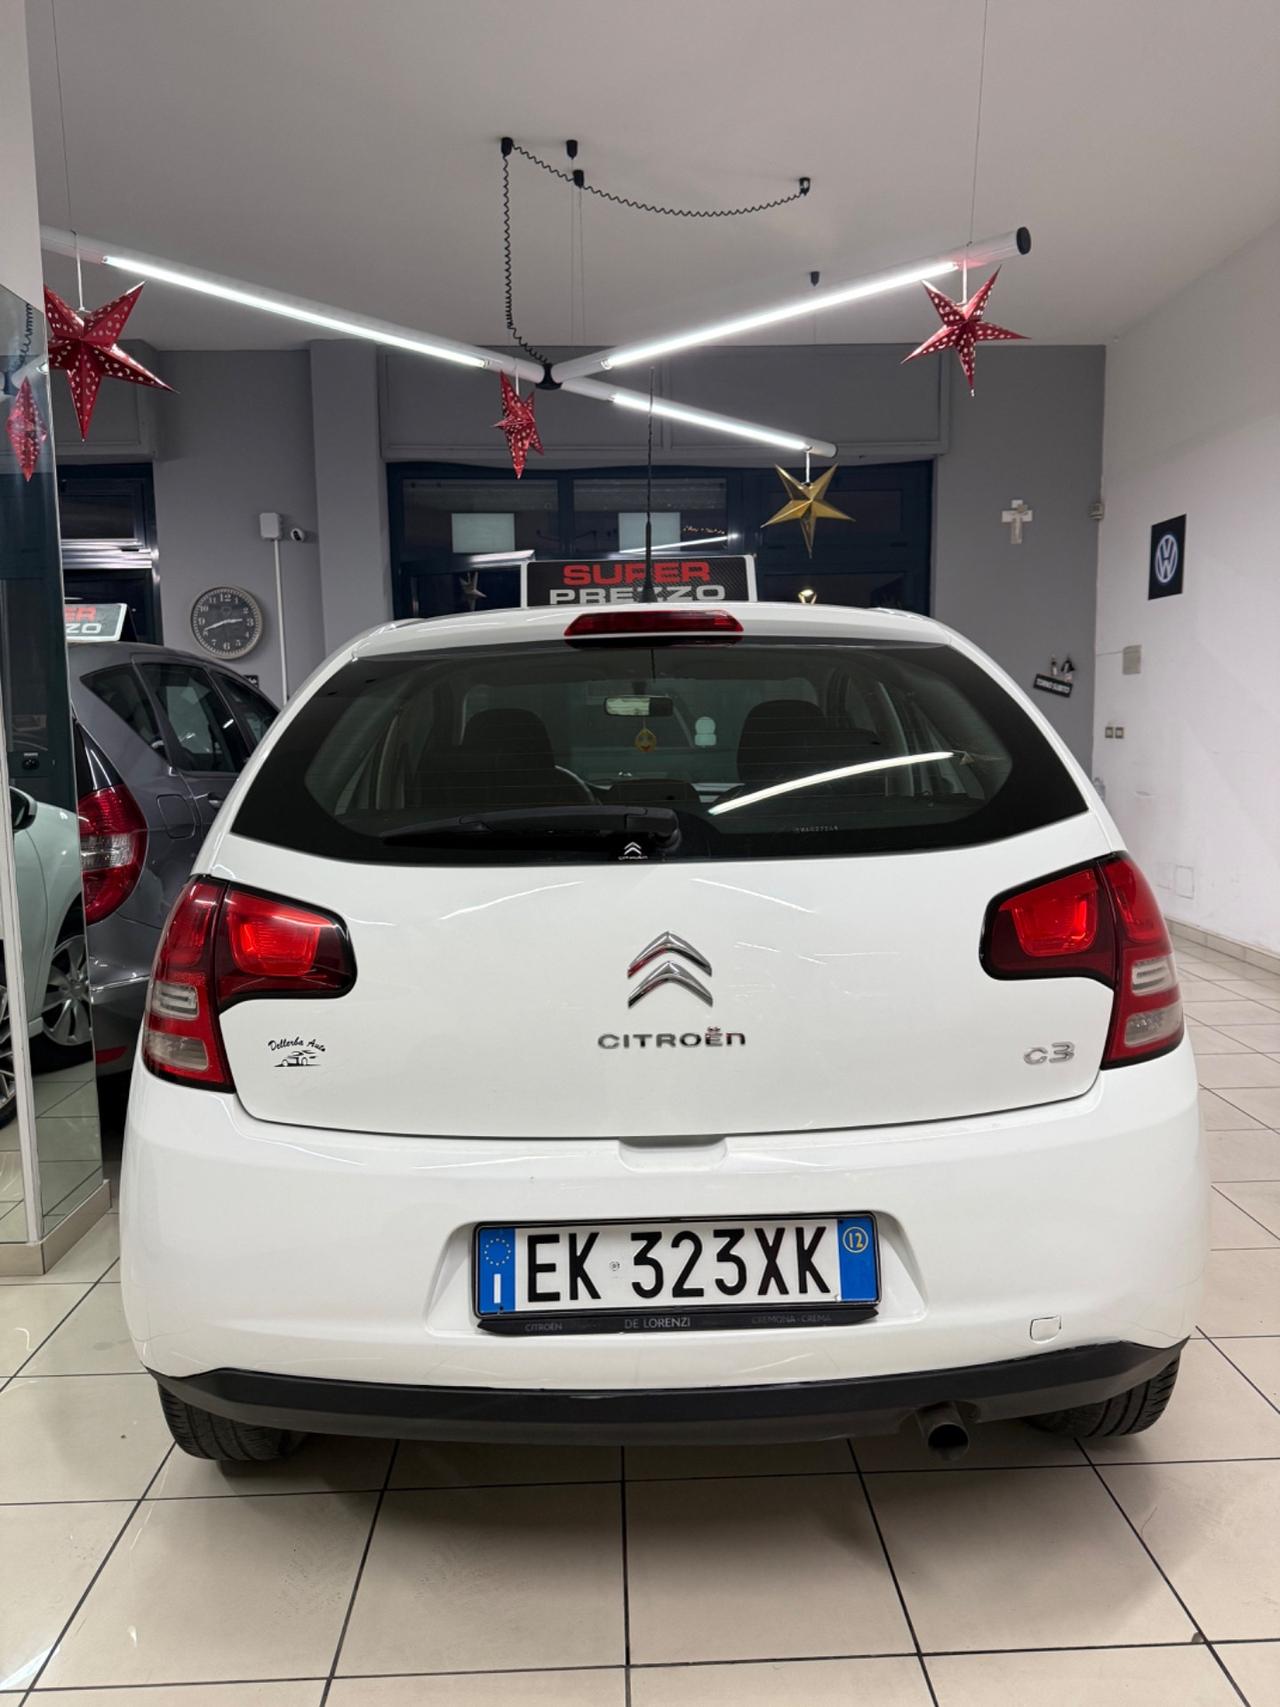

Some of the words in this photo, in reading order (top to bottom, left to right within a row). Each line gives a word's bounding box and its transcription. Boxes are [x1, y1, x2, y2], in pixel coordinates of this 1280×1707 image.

[563, 562, 711, 585] SUPER
[1023, 1041, 1075, 1065] C3
[849, 1231, 864, 1248] 12
[527, 1231, 602, 1303] EK
[629, 1226, 831, 1299] 323XK
[624, 1318, 640, 1329] DE
[643, 1316, 691, 1329] LORENZI
